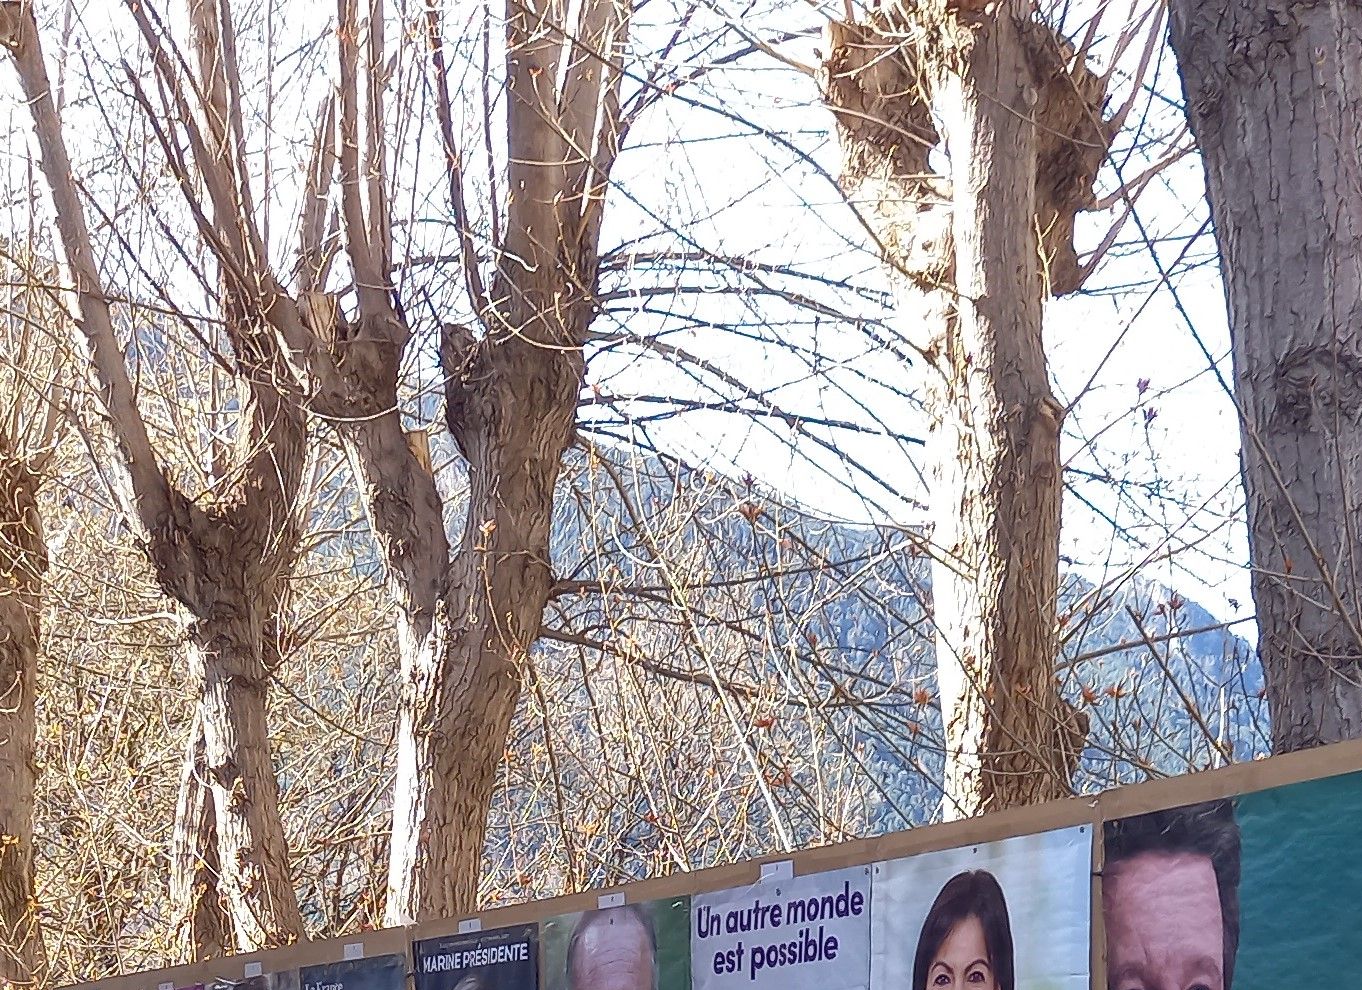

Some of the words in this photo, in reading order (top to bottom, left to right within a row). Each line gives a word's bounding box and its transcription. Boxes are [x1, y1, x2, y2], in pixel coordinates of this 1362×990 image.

[697, 905, 722, 939] Un
[725, 899, 782, 934] autre
[786, 881, 864, 926] monde
[423, 953, 460, 972] MARINE
[462, 943, 528, 969] PRÉSIDENTE
[713, 942, 745, 975] est
[751, 926, 839, 981] possible
